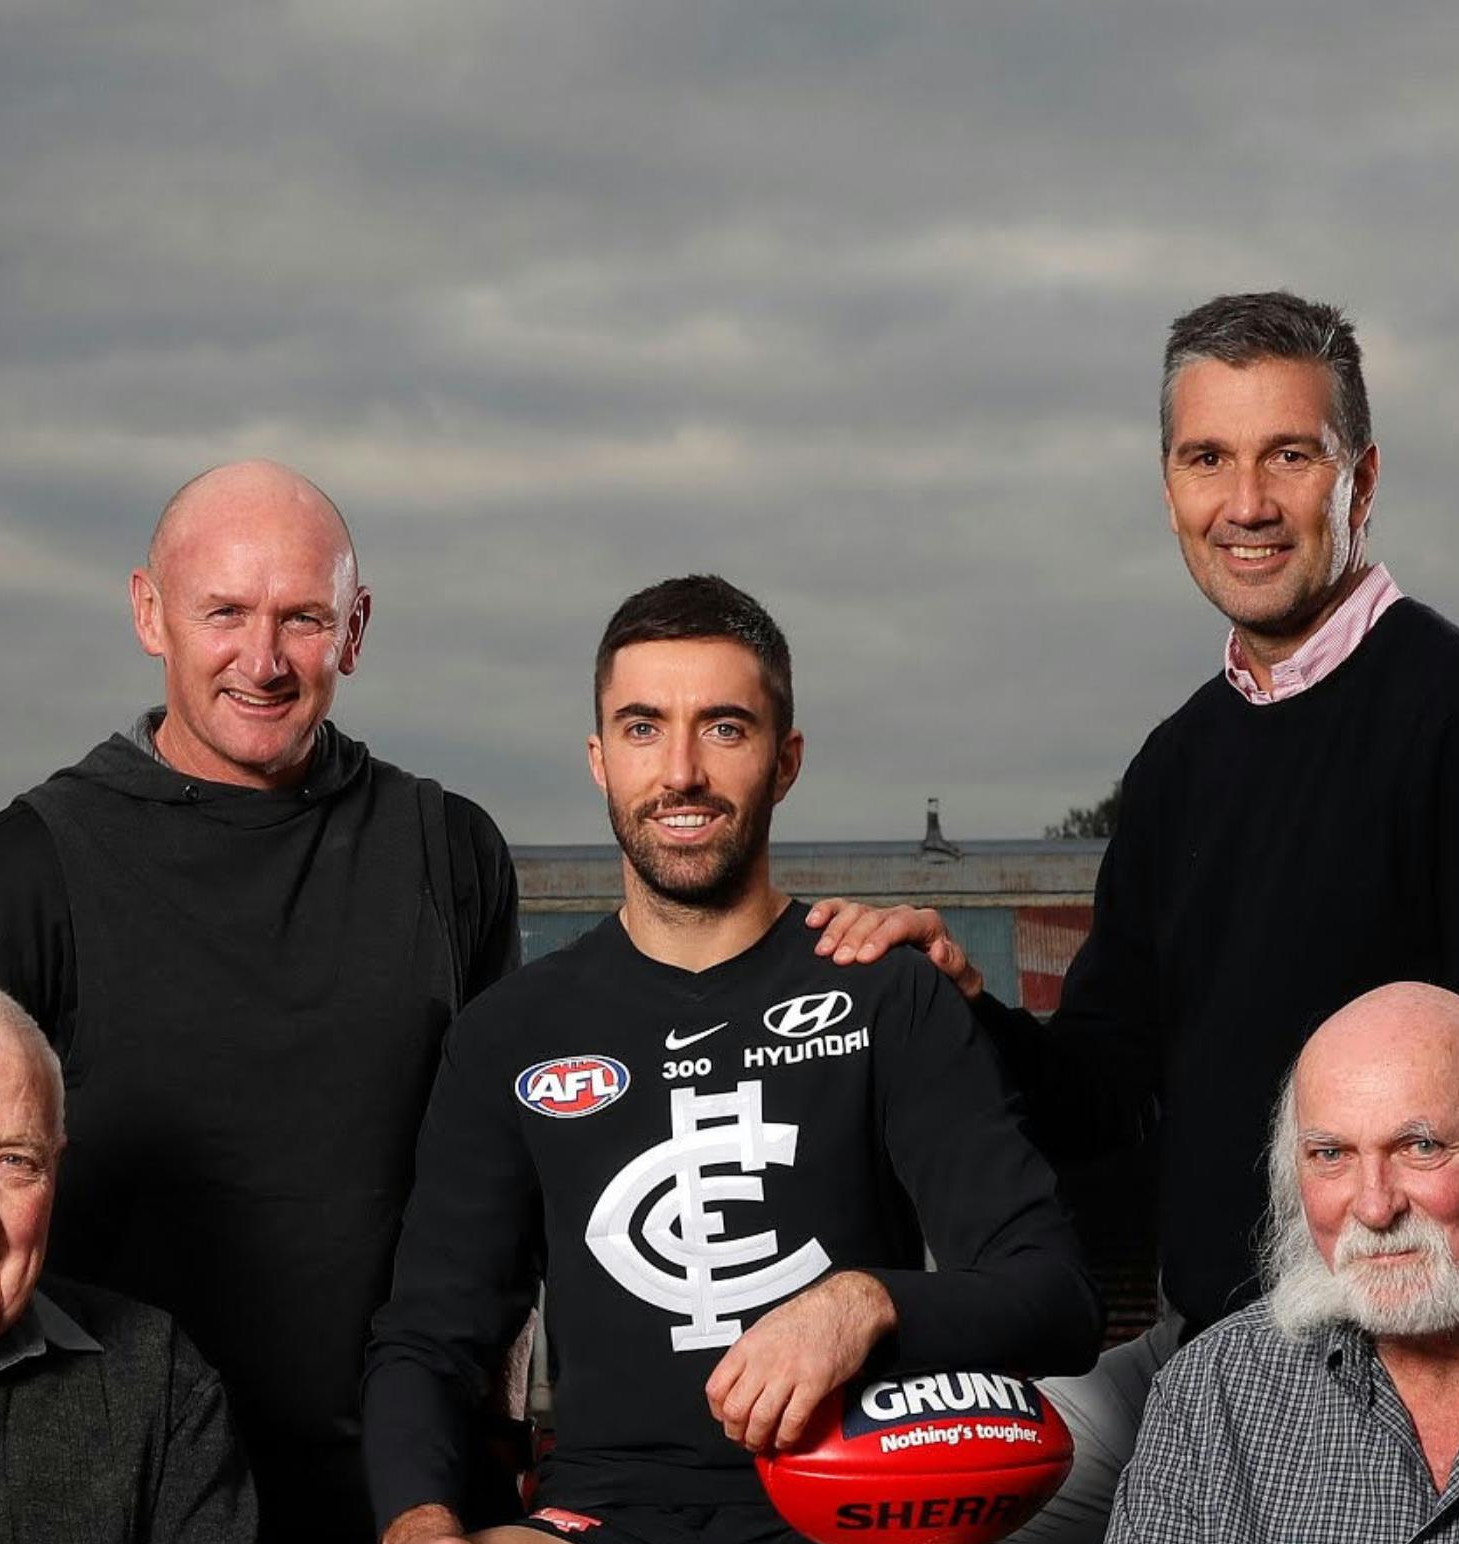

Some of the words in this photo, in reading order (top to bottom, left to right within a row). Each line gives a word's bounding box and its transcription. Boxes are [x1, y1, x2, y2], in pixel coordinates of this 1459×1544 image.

[743, 1026, 870, 1069] HYUNDAI
[526, 1066, 620, 1103] AFL
[661, 1056, 713, 1081] 300
[880, 1424, 973, 1453] Nothing's
